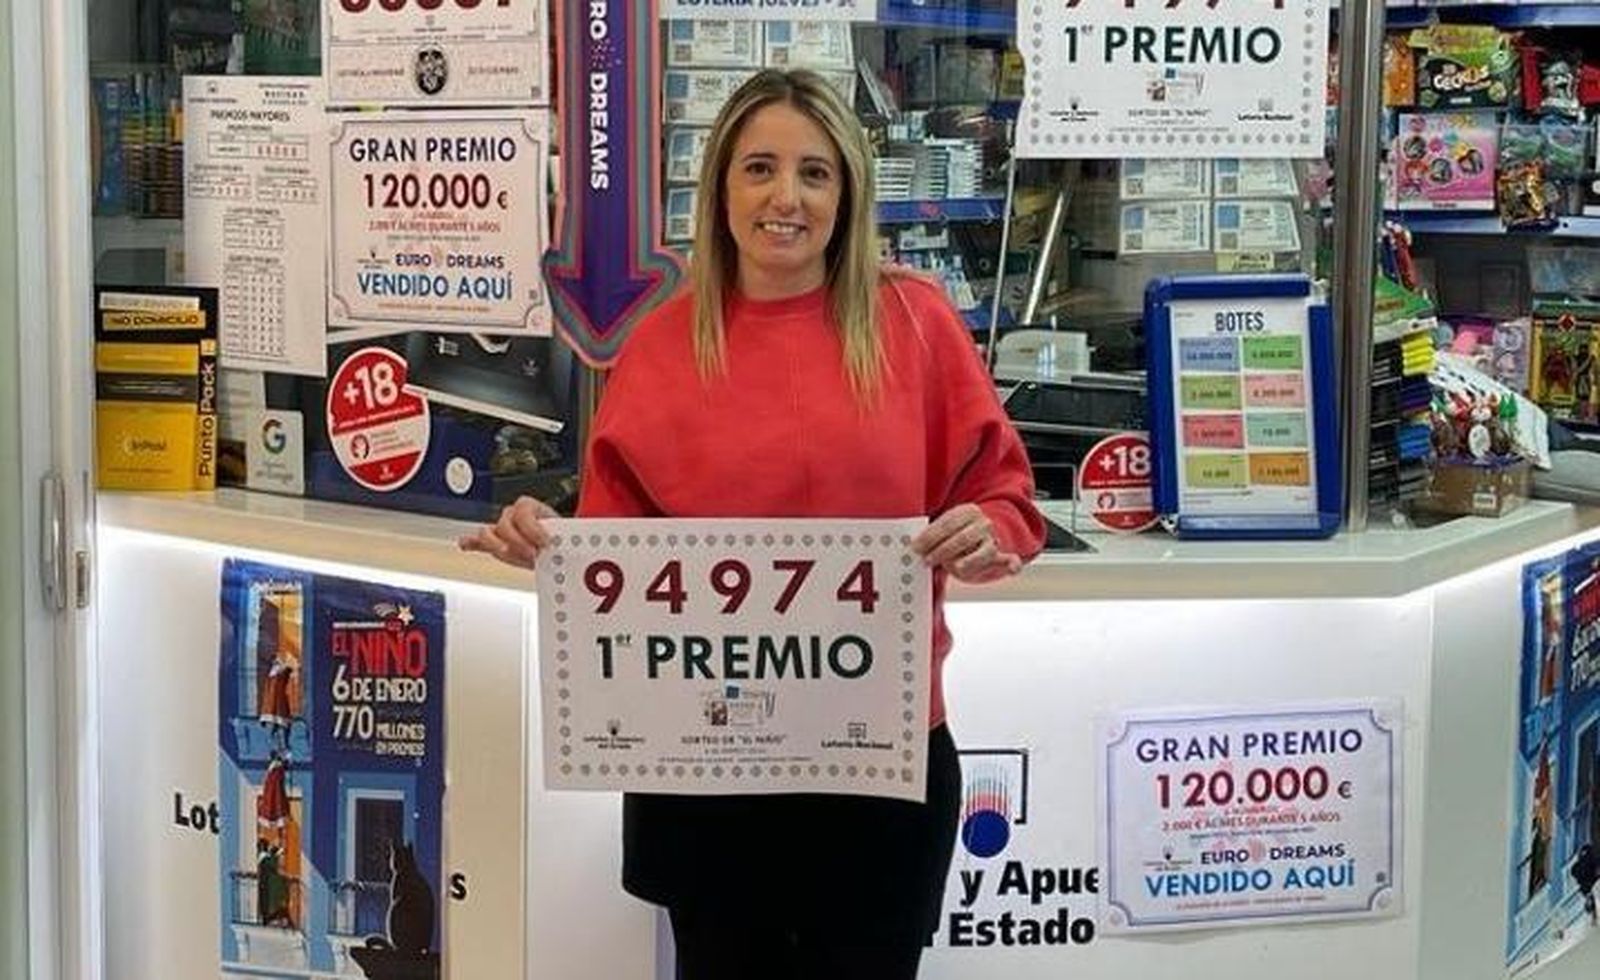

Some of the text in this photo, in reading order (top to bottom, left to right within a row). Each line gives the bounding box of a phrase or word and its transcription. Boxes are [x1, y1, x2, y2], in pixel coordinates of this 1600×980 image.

[1104, 26, 1282, 64] PREMIO
[350, 137, 517, 163] GRAN PREMIO
[590, 72, 609, 190] DREAMS
[363, 173, 508, 210] 120.000 €
[395, 254, 432, 267] EURO
[446, 255, 505, 269] DREAMS
[357, 271, 513, 300] VENDIDO AQUÍ
[1215, 311, 1265, 332] BOTES
[343, 361, 399, 409] +18
[198, 362, 216, 476] Punto Pack
[1100, 445, 1151, 476] +18
[583, 559, 880, 614] 94974
[331, 629, 429, 678] EL NIÑO
[646, 634, 874, 681] PREMIO
[332, 664, 428, 703] 6 DE ENERO
[332, 705, 426, 741] 770 MILLONES
[1136, 728, 1364, 764] GRAN PREMIO
[1156, 765, 1353, 810] 120.000 €
[1245, 814, 1297, 828] DURANTE
[175, 792, 468, 900] Lot s
[1201, 848, 1250, 865] EURO
[1269, 843, 1346, 861] DREAMS
[960, 869, 985, 907] y
[1144, 858, 1355, 898] VENDIDO AQUÍ
[949, 908, 1096, 947] Estado
